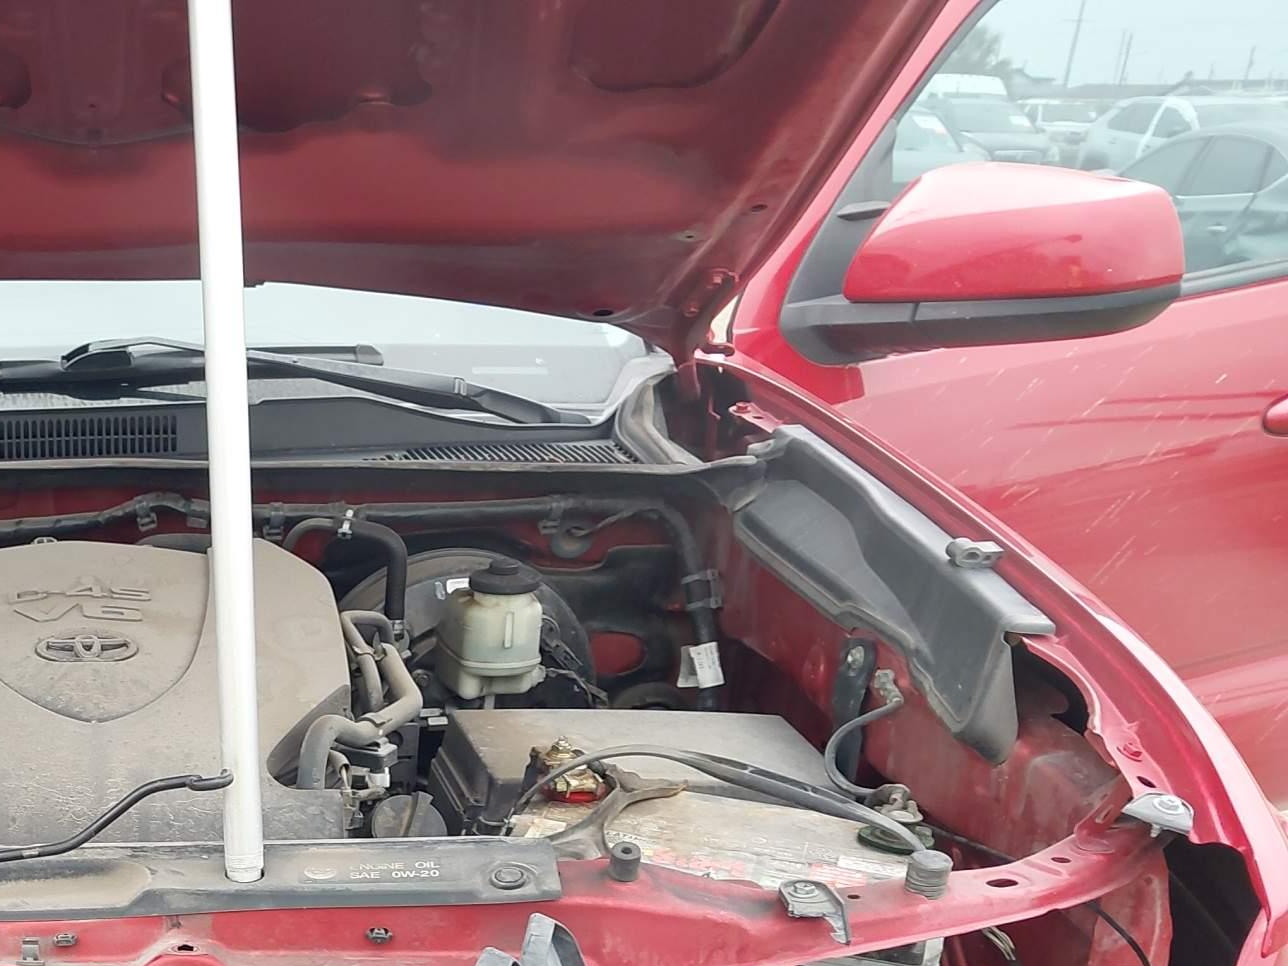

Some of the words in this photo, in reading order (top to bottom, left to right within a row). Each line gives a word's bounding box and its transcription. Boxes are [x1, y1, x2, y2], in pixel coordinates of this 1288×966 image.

[414, 861, 440, 869] OIL
[350, 871, 381, 879] SAE
[391, 869, 440, 879] 0W-20
